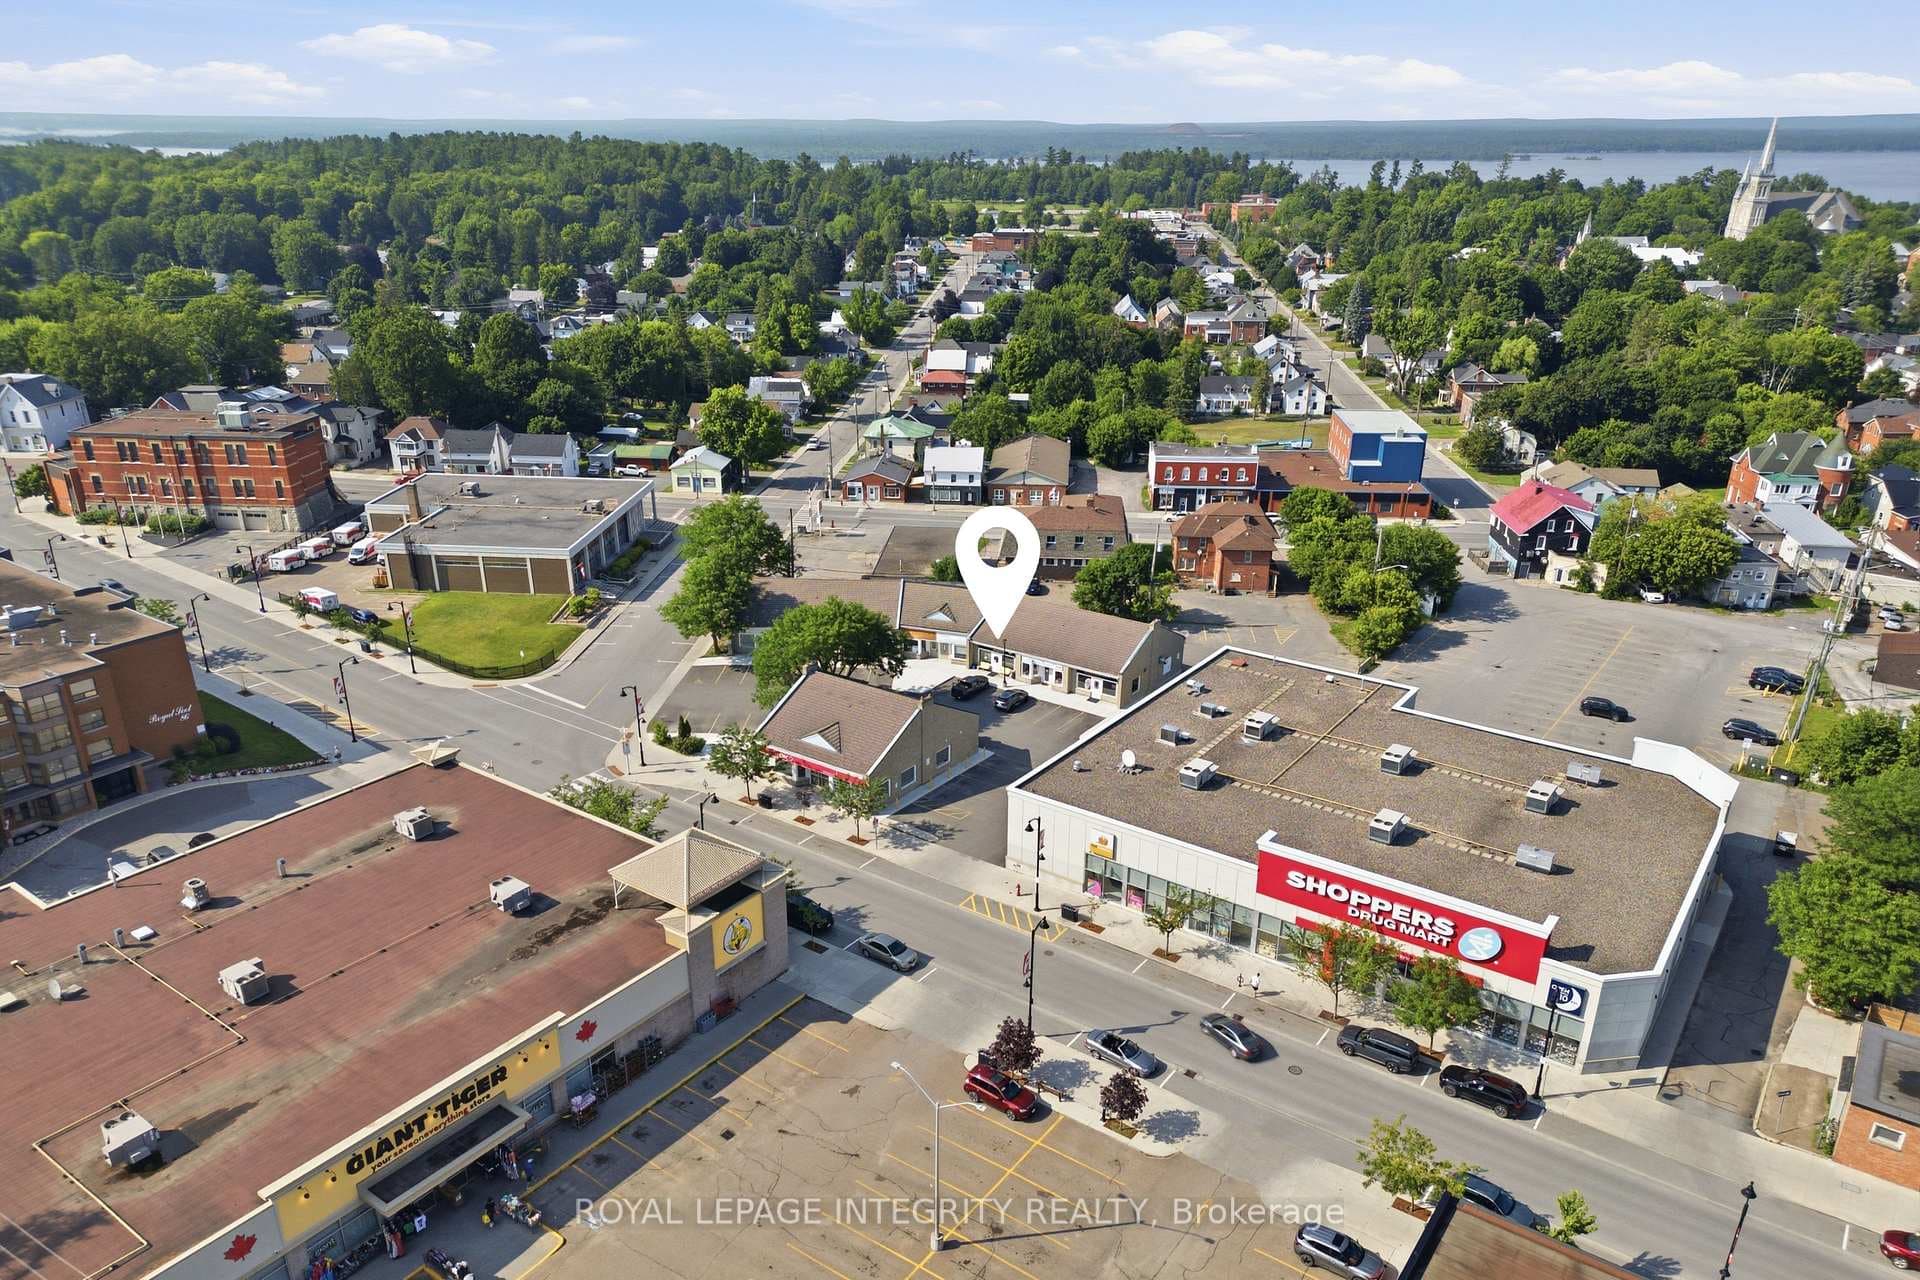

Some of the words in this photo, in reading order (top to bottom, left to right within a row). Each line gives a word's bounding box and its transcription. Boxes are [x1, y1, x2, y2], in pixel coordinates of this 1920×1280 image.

[1285, 870, 1455, 938] SHOPPERS
[1347, 906, 1396, 930] DRUG
[1399, 923, 1452, 948] MART
[346, 1112, 428, 1175] GIANT
[434, 1066, 508, 1119] TIGER
[470, 1093, 490, 1109] store
